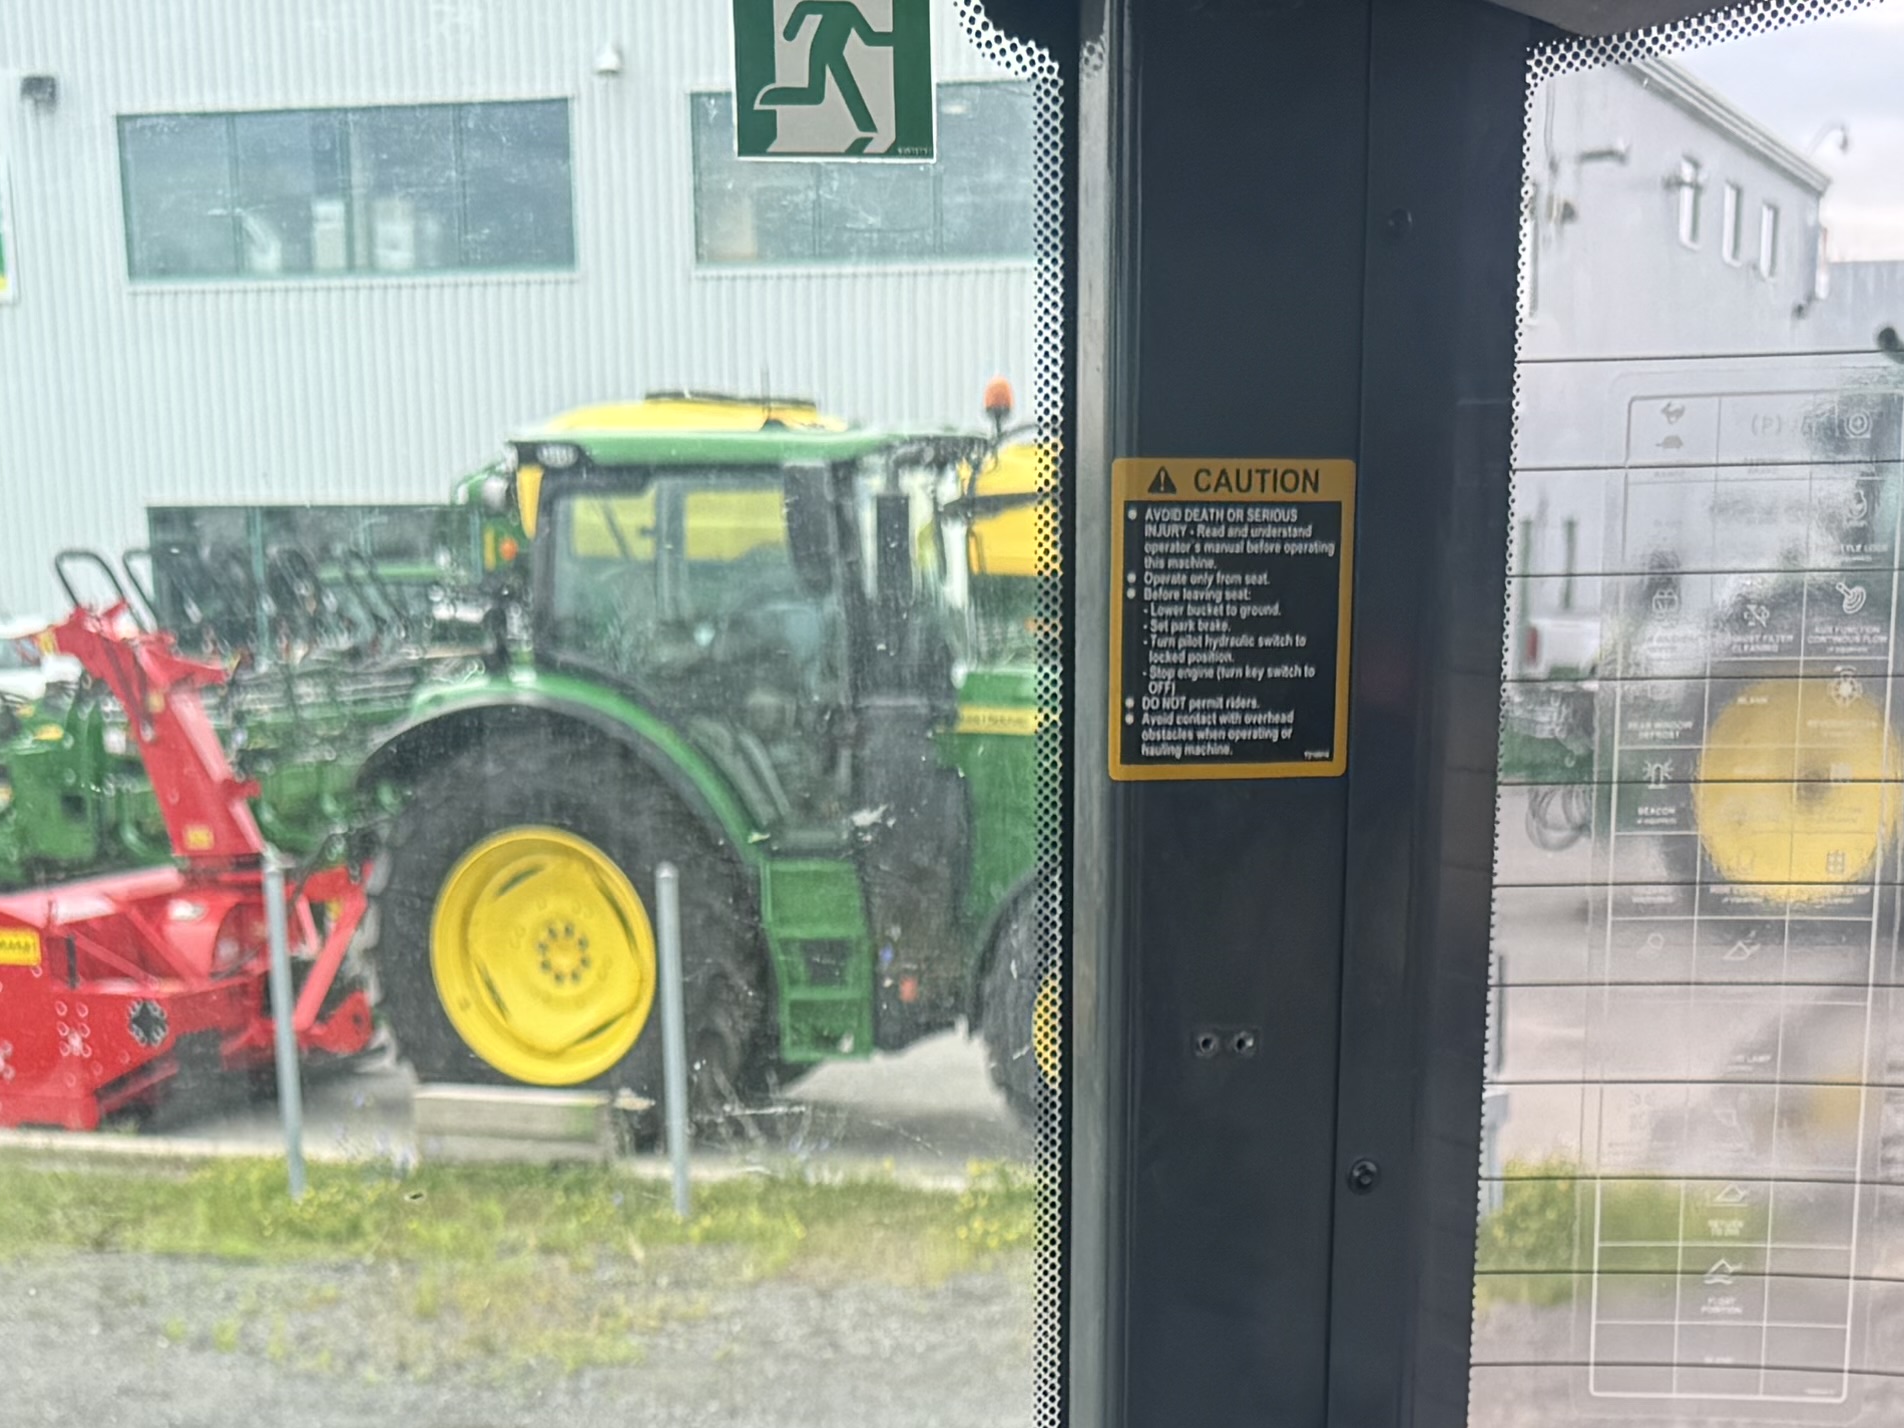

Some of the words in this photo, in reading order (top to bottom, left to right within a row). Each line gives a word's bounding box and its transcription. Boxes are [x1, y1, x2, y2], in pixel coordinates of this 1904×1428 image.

[1194, 468, 1320, 494] CAUTION
[1145, 507, 1182, 522] AVOID
[1184, 507, 1225, 522] DEATH
[1227, 507, 1244, 522] OR
[1247, 507, 1298, 522] SERIOUS
[1144, 523, 1187, 537] INJURY
[1197, 523, 1225, 538] Read
[1227, 524, 1249, 538] and
[1250, 524, 1313, 538] understand
[1203, 540, 1244, 554] manual
[1246, 539, 1281, 554] before
[1283, 541, 1335, 557] operating
[1144, 555, 1165, 569] this
[1144, 570, 1187, 587] Operate
[1190, 572, 1214, 590] only
[1216, 570, 1243, 585] from
[1144, 586, 1181, 601] Before
[1183, 587, 1223, 603] leaving
[1150, 601, 1184, 617] Lower
[1187, 602, 1224, 617] bucket
[1226, 602, 1238, 616] to
[1239, 601, 1281, 620] ground.
[1150, 618, 1169, 633] Set
[1170, 619, 1196, 635] park
[1150, 634, 1176, 648] Turn
[1177, 634, 1202, 650] pilot
[1204, 633, 1255, 651] hydraulic
[1258, 632, 1293, 648] switch
[1295, 634, 1307, 648] to
[1149, 649, 1186, 664] locked
[1149, 664, 1176, 681] Stop
[1177, 666, 1215, 682] engine
[1245, 664, 1265, 682] key
[1266, 664, 1302, 678] switch
[1304, 664, 1316, 678] to
[1142, 695, 1160, 710] DO
[1161, 695, 1186, 710] NOT
[1188, 696, 1224, 713] permit
[1141, 711, 1175, 726] Avoid
[1176, 710, 1217, 726] contact
[1218, 711, 1242, 725] with
[1243, 708, 1295, 725] overhead
[1141, 726, 1194, 742] obstacles
[1196, 726, 1227, 740] when
[1227, 726, 1280, 743] operating
[1280, 726, 1293, 739] or
[1141, 742, 1183, 760] hauling
